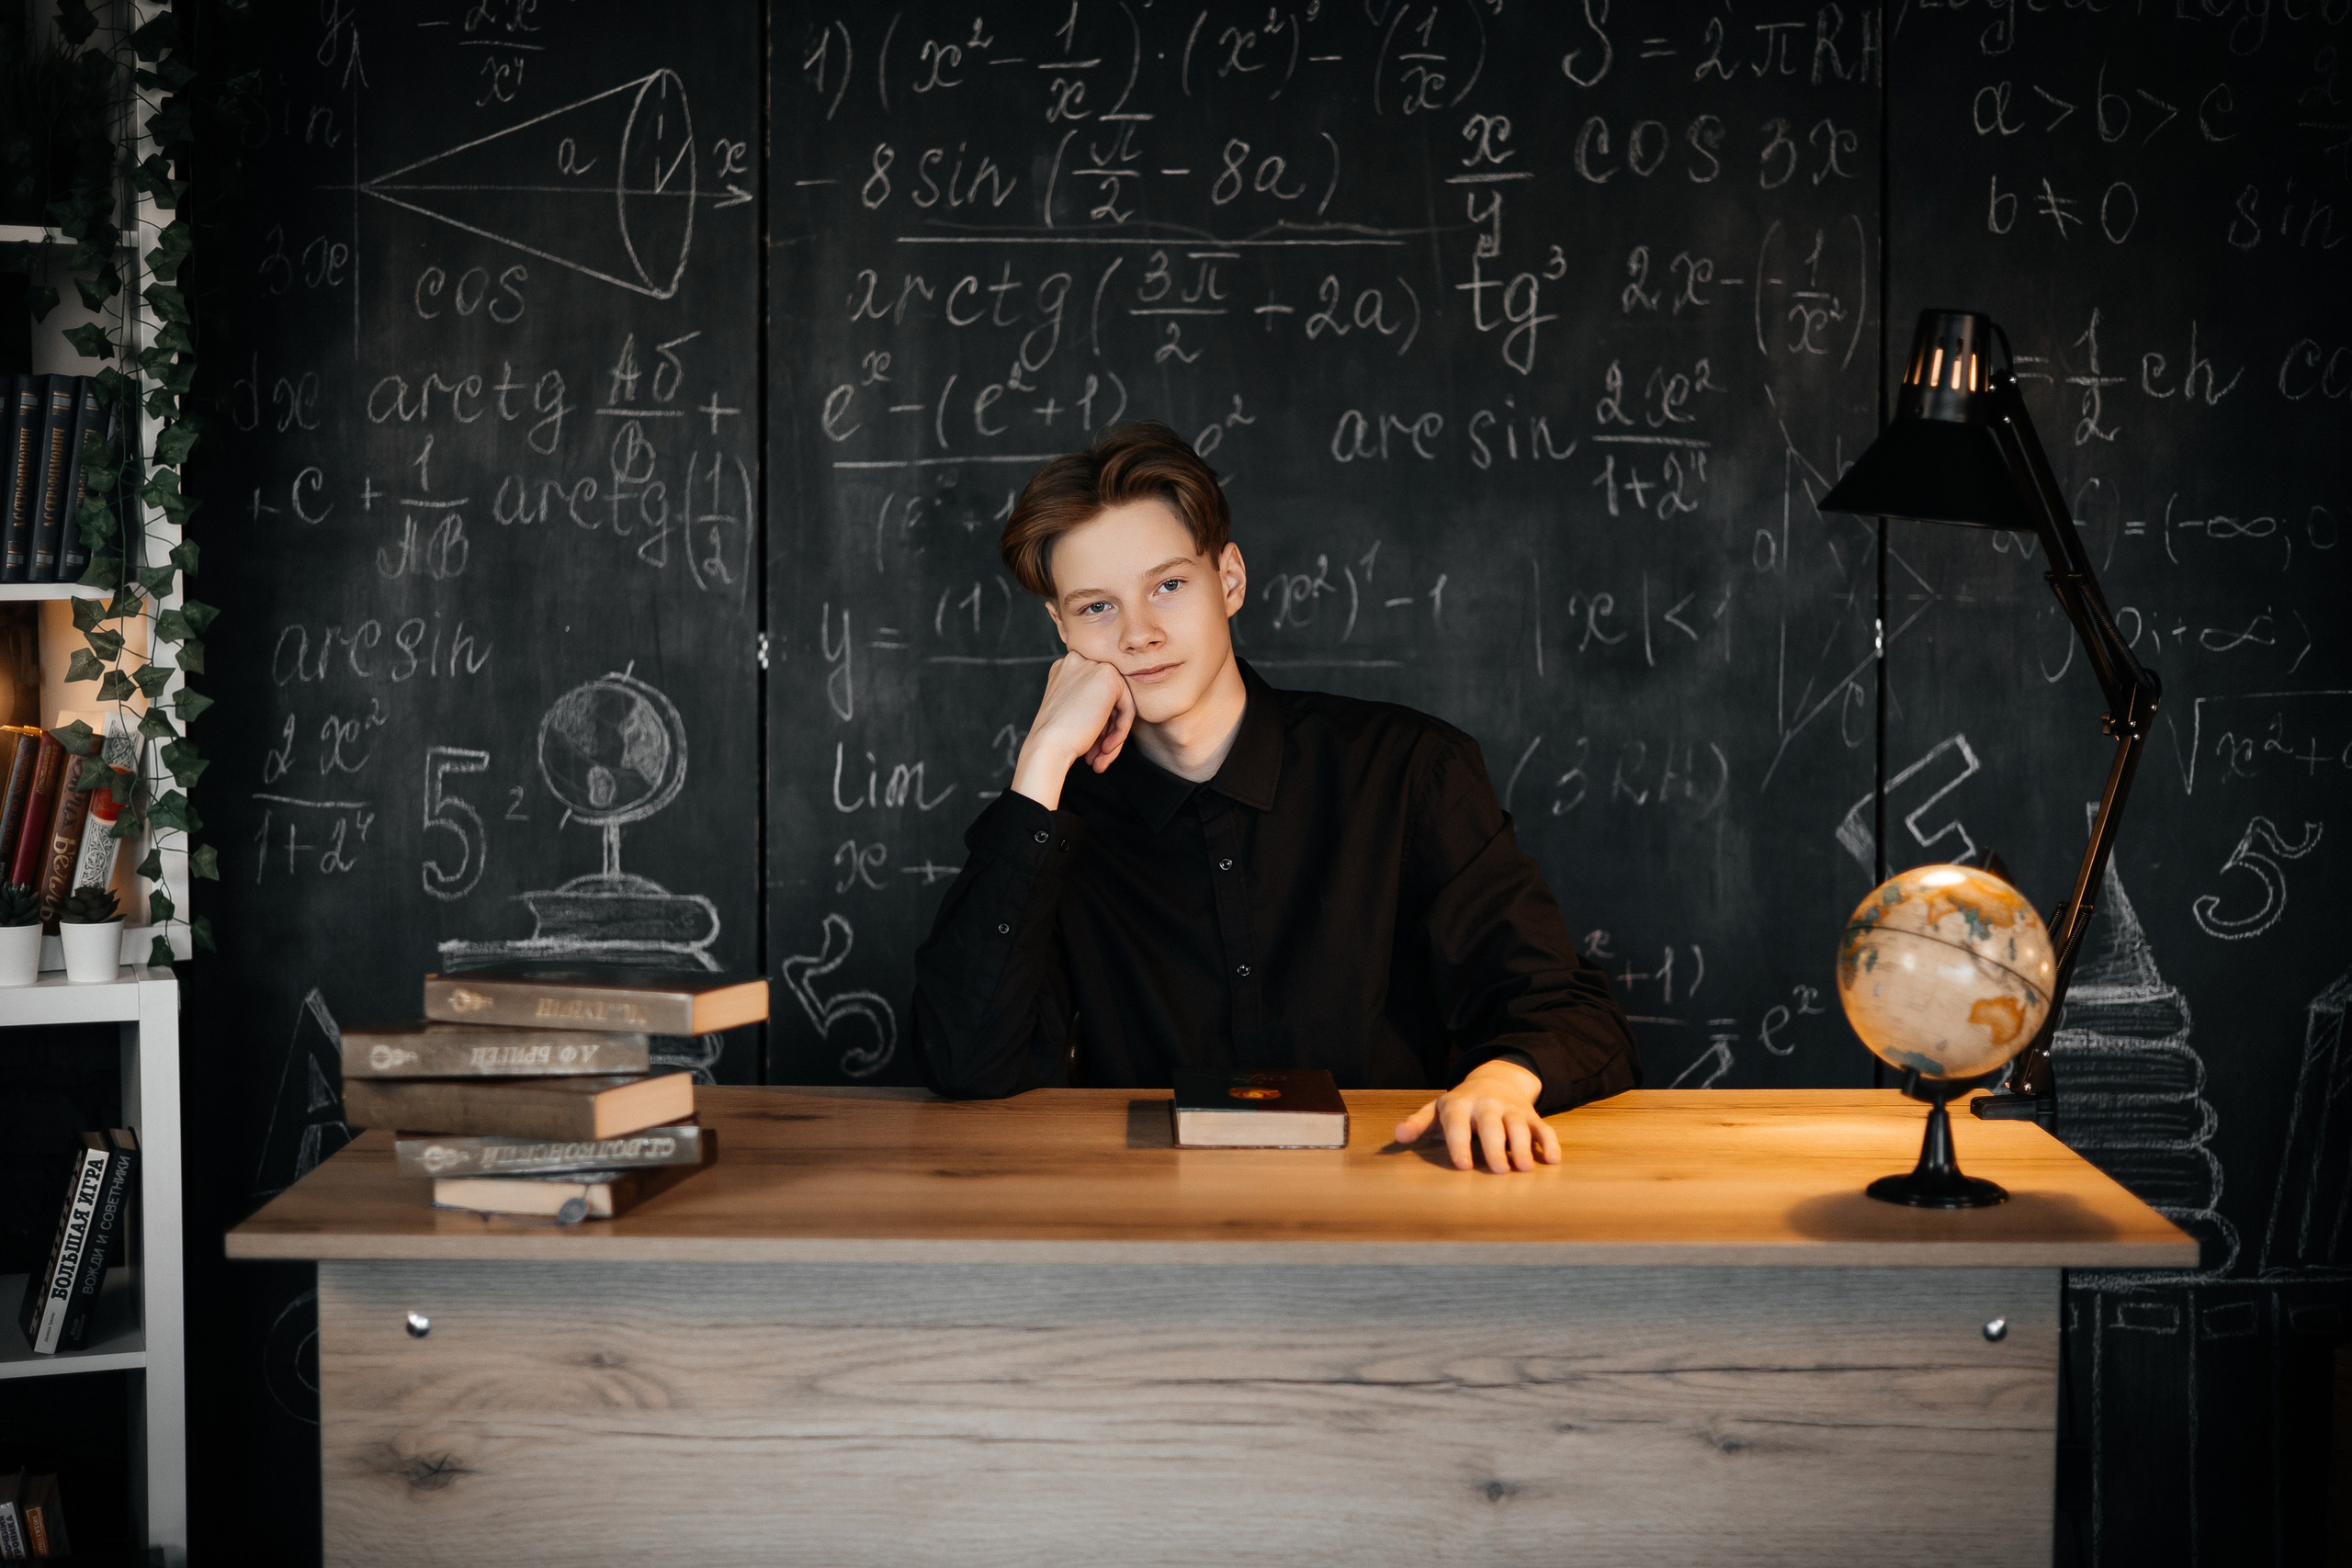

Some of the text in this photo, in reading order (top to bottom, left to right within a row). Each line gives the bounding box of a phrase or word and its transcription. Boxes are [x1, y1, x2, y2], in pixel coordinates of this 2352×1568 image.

[413, 265, 528, 324] cos
[51, 1208, 90, 1302] БОЛЬШАЯ
[77, 1158, 105, 1207] ИГРА
[83, 1155, 131, 1295] ВОЖДИ И СОВЕТНИКИ
